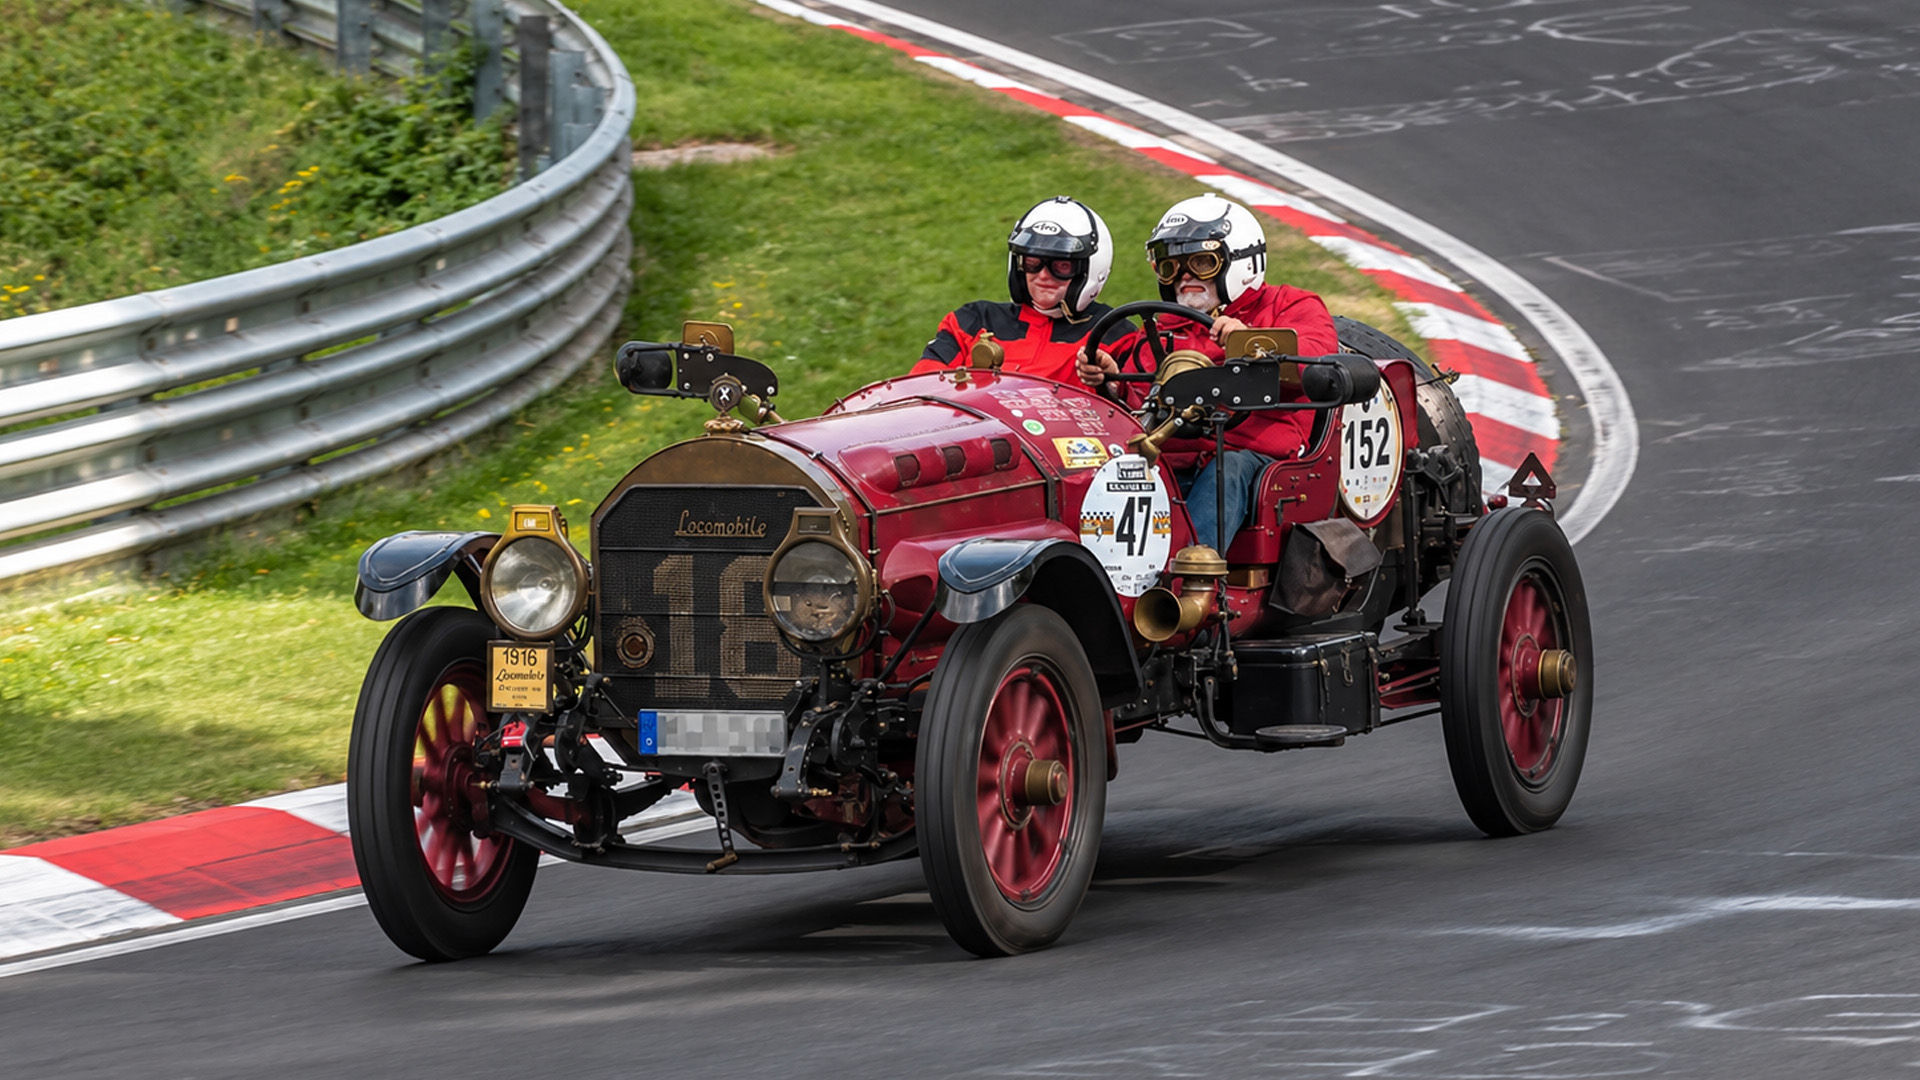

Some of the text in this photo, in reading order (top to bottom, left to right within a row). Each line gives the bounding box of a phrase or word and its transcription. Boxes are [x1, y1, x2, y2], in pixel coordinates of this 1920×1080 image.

[1345, 417, 1390, 470] 152
[674, 509, 767, 538] Locomobile
[1115, 496, 1152, 556] 47
[503, 647, 537, 666] 1916
